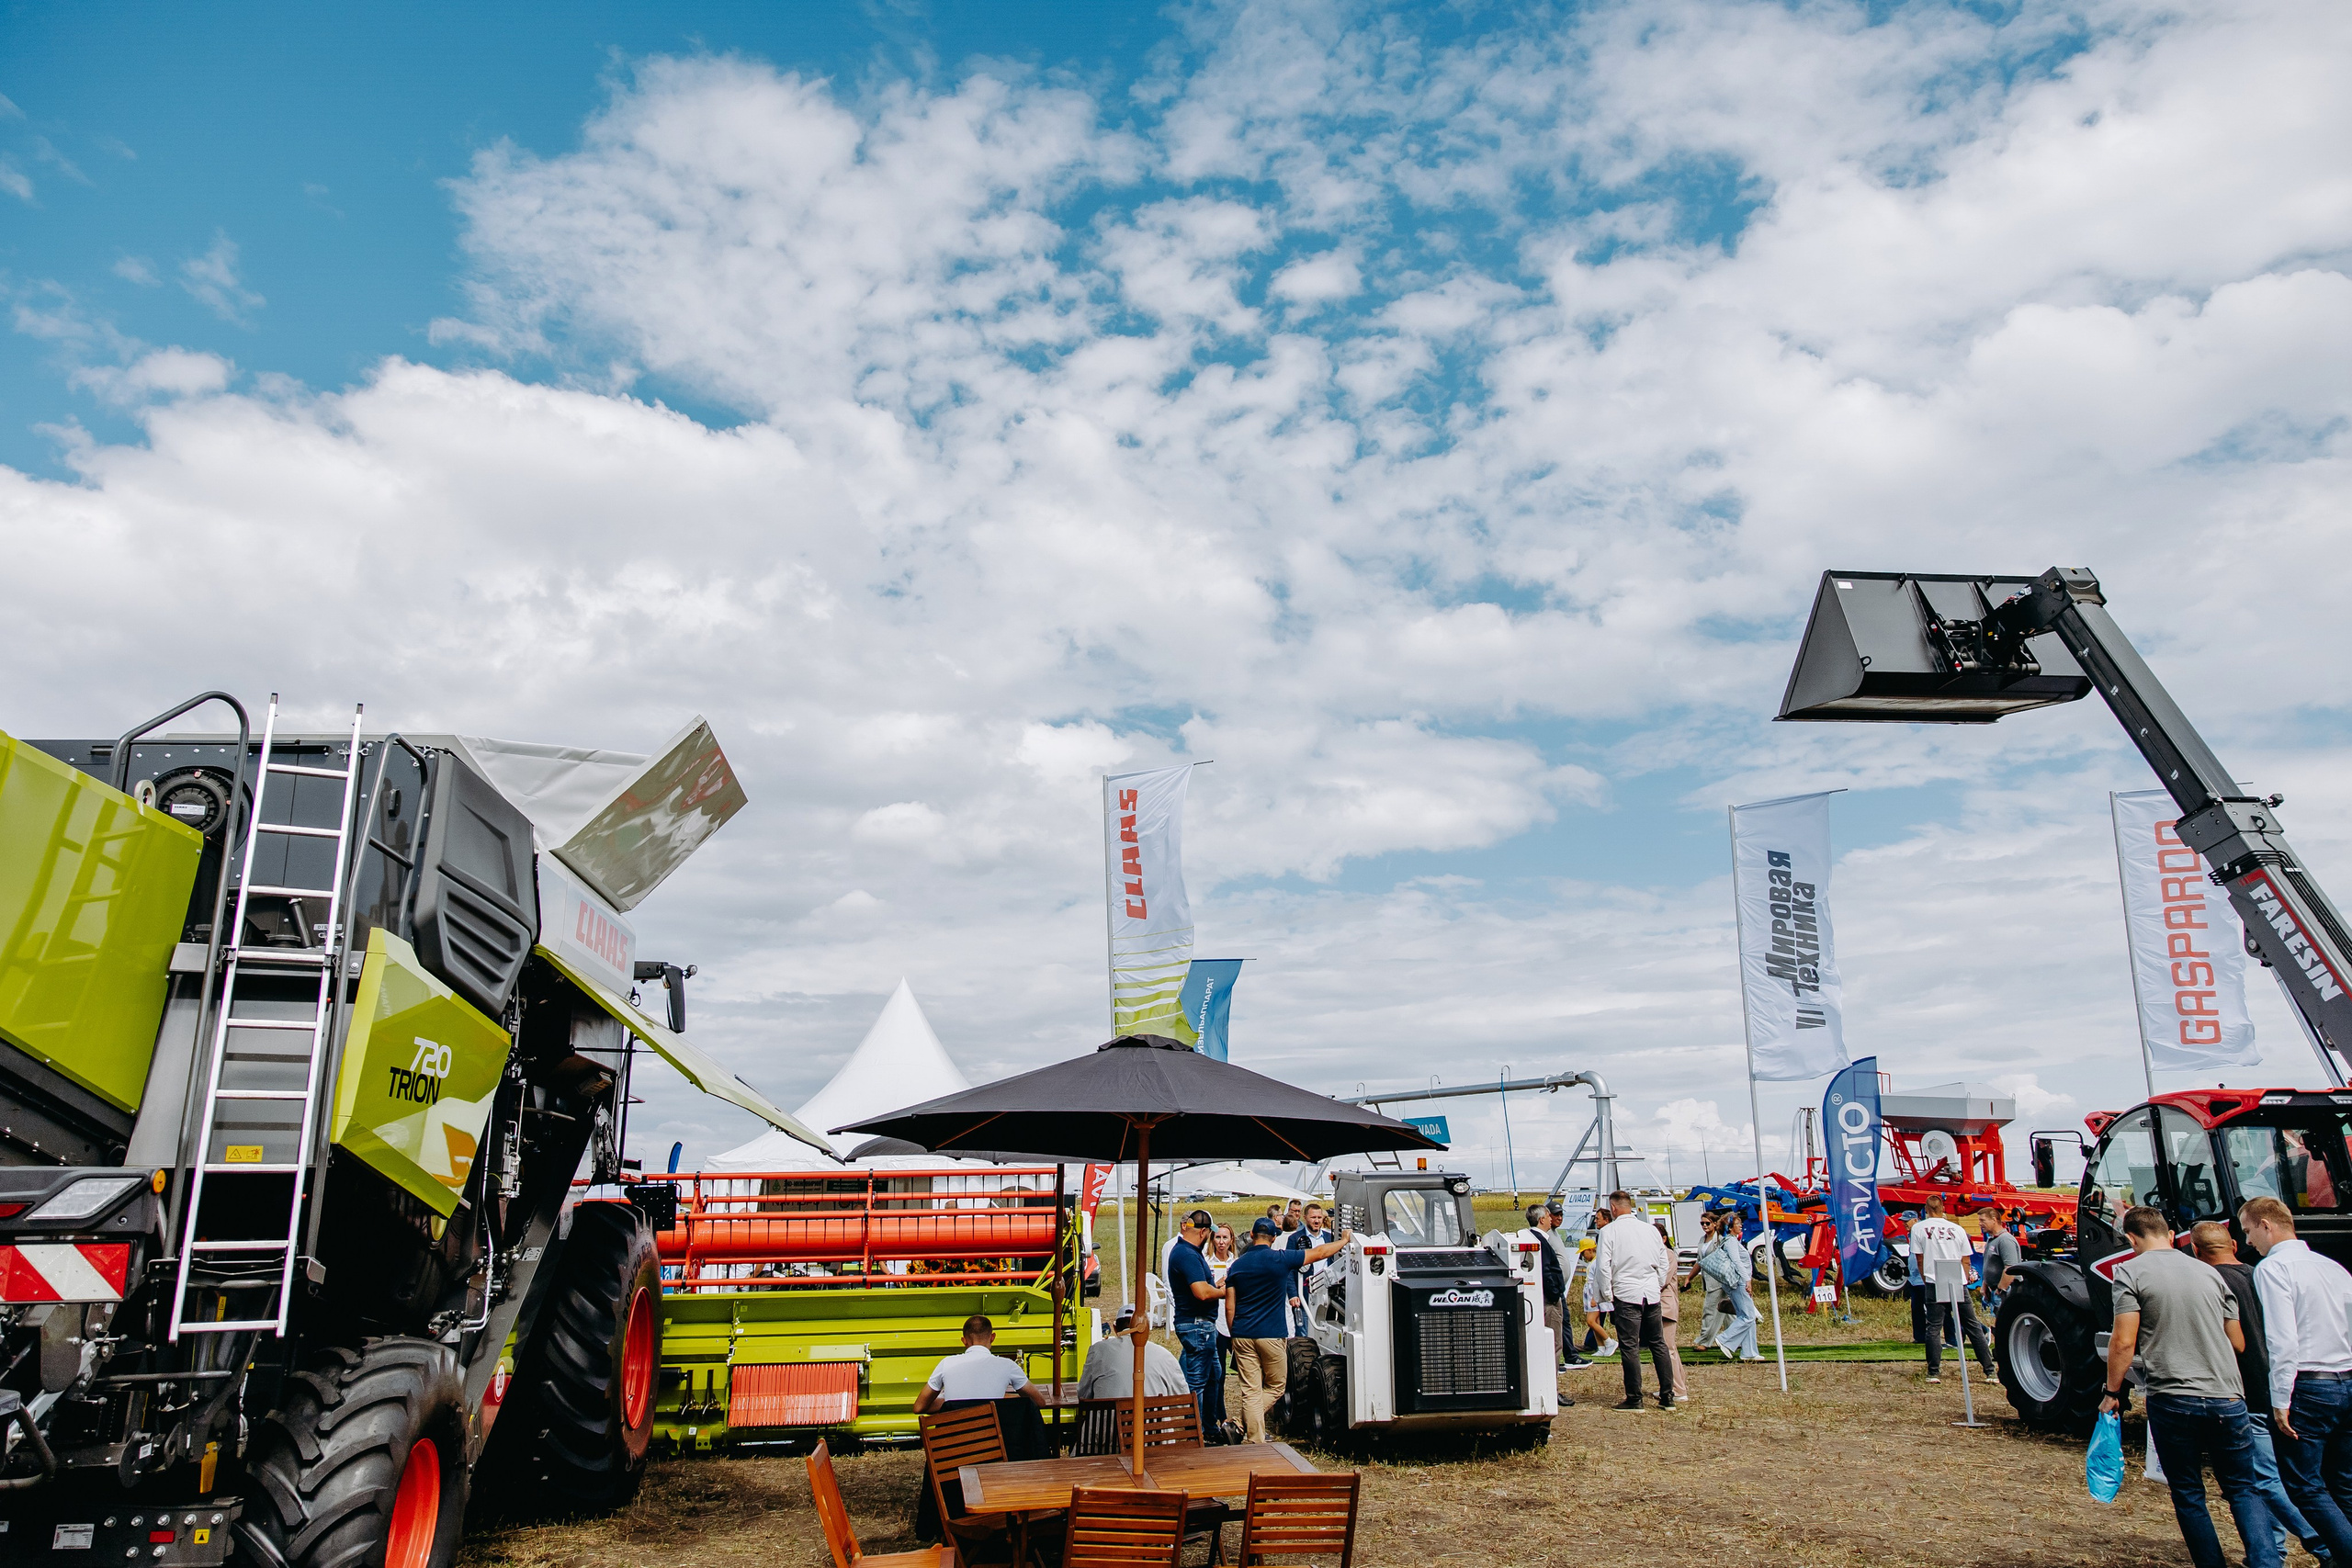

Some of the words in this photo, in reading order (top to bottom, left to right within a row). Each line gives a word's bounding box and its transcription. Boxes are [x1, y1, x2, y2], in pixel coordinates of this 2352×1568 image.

[1119, 789, 1148, 919] CLAAS
[575, 899, 628, 974] CLAAS
[1765, 850, 1798, 982] Мировая
[2154, 819, 2222, 1045] GASPARDO
[2247, 882, 2344, 1002] FARESIN
[1197, 976, 1215, 1055] ИЗЕЛЬАППАРАТ
[389, 1066, 441, 1105] TRION
[410, 1036, 452, 1079] 720
[1568, 1194, 1591, 1203] LIVADA
[1817, 1292, 1833, 1302] 110
